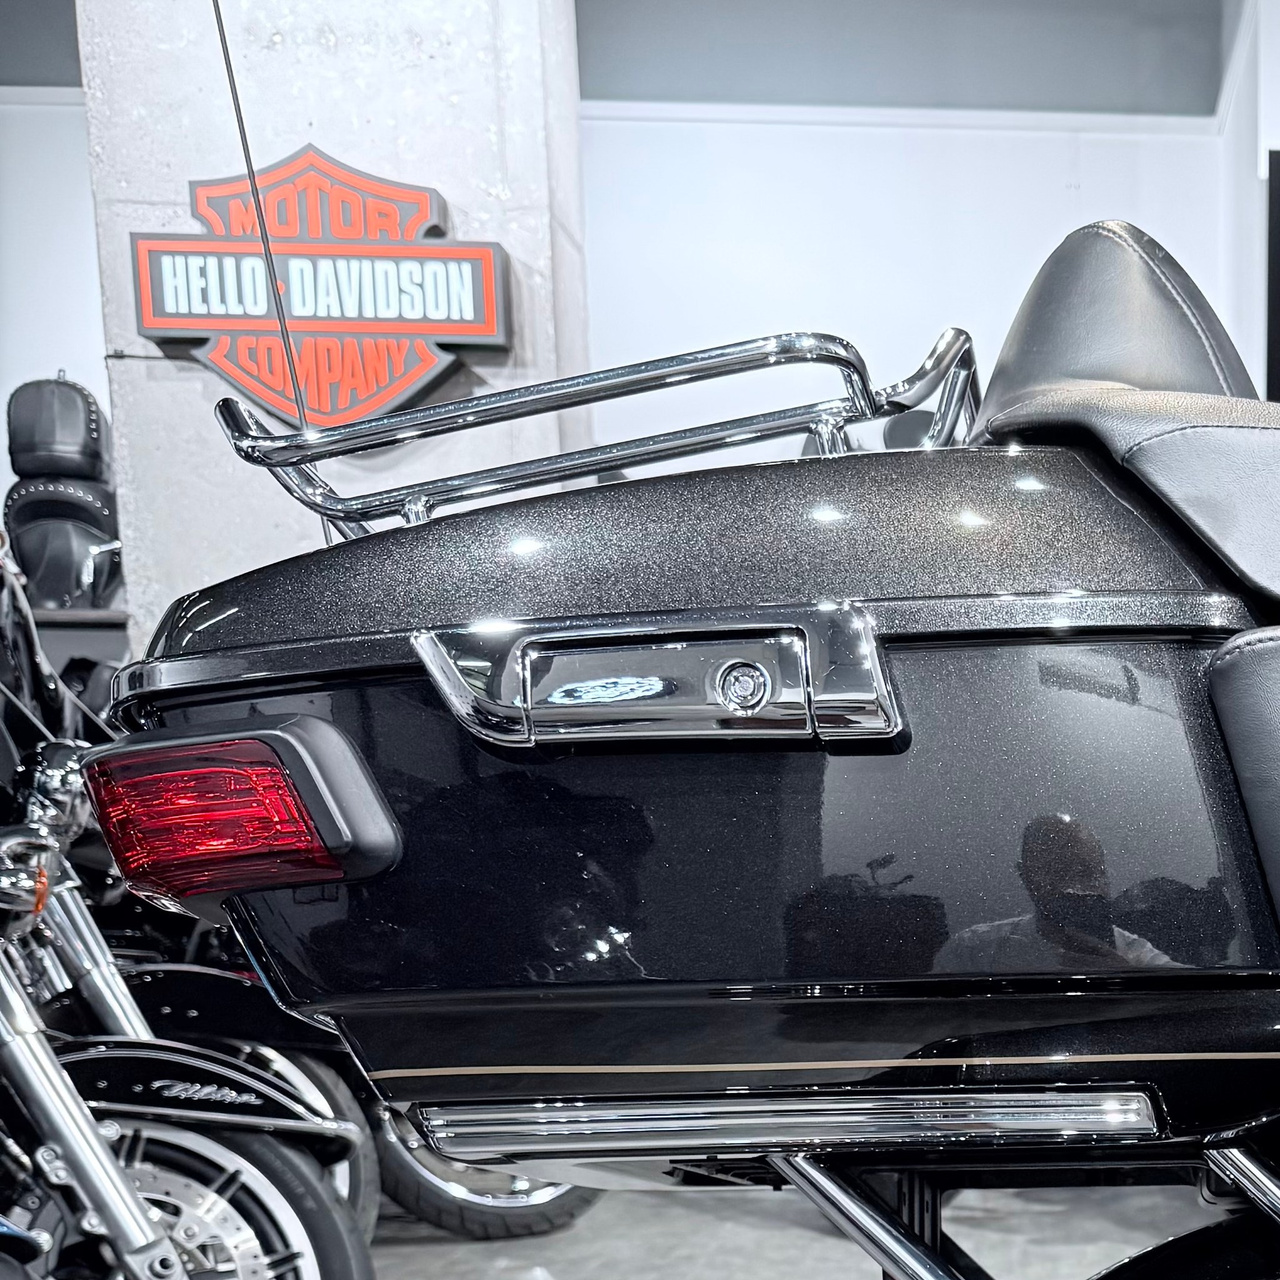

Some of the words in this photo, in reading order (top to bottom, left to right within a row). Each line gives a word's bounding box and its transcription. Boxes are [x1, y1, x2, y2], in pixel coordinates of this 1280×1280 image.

[228, 171, 401, 240] MOTOR
[161, 254, 268, 316] HELLO
[288, 257, 475, 321] DAVIDSON
[236, 336, 409, 413] COMPANY
